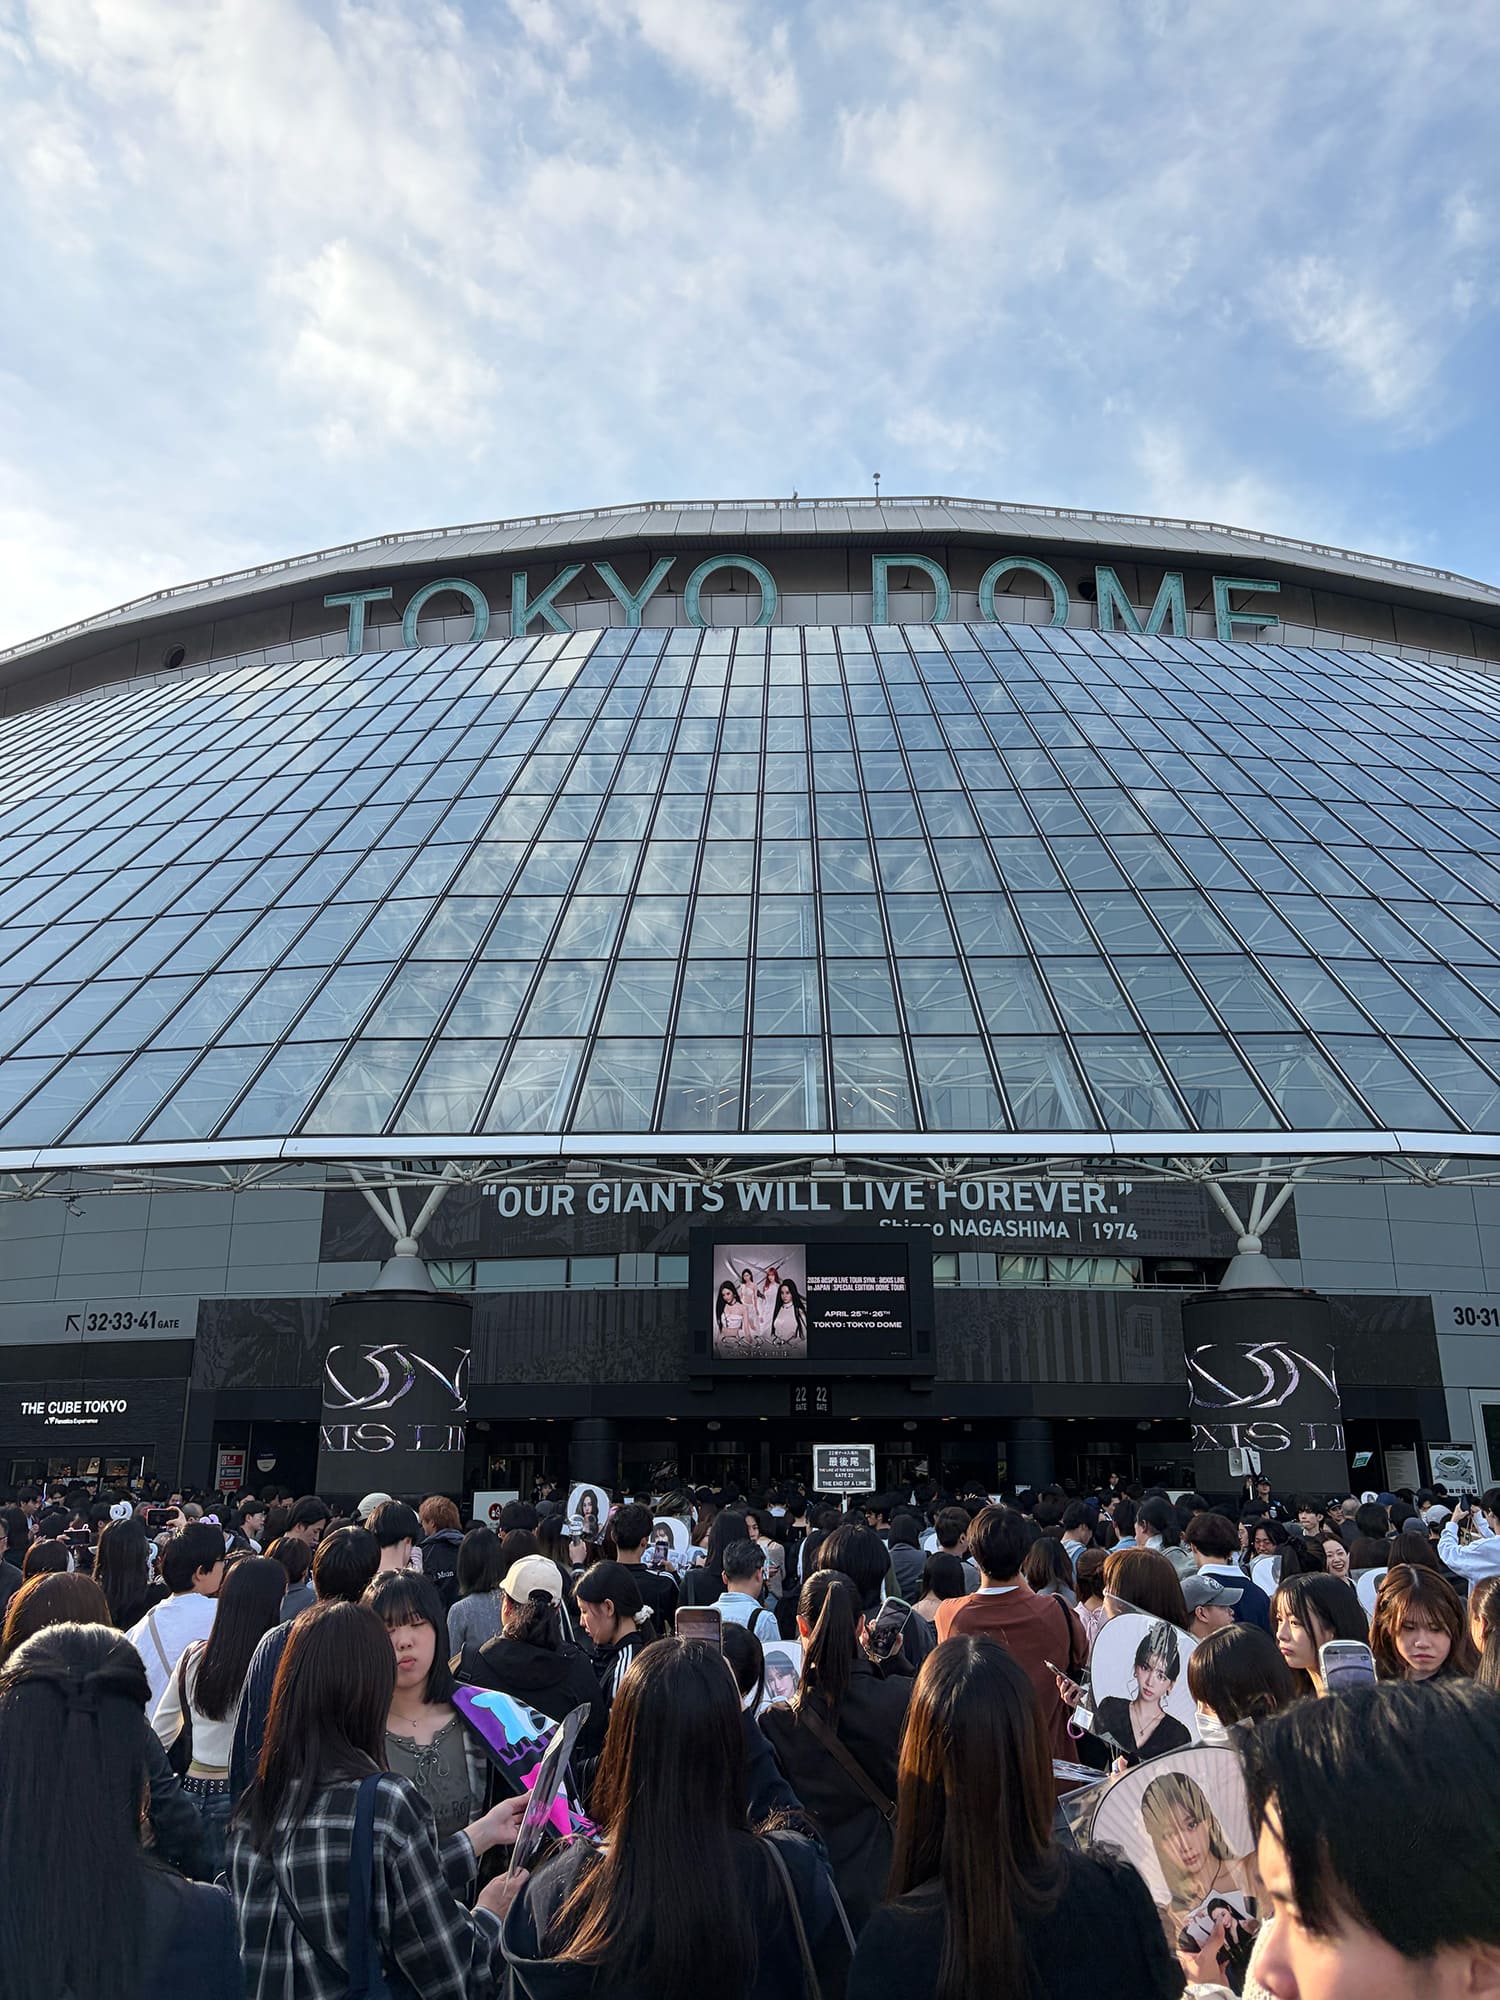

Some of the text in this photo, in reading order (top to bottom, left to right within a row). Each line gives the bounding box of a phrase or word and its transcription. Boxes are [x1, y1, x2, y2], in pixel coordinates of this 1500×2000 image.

[324, 554, 1281, 654] TOKYO DOME
[587, 1182, 724, 1214] GIANTS
[737, 1181, 831, 1213] WILL
[843, 1181, 925, 1211] LIVE
[951, 1219, 1070, 1239] NAGASHIMA
[1092, 1221, 1138, 1241] 1974
[158, 1319, 180, 1329] GATE
[813, 1321, 842, 1329] TOKYO
[846, 1321, 875, 1329] TOKYO
[877, 1321, 902, 1329] DOME
[795, 1386, 807, 1402] 22
[816, 1386, 827, 1402] 22
[21, 1400, 127, 1415] THE CUBE TOKYO
[829, 1457, 859, 1466] 最後尾
